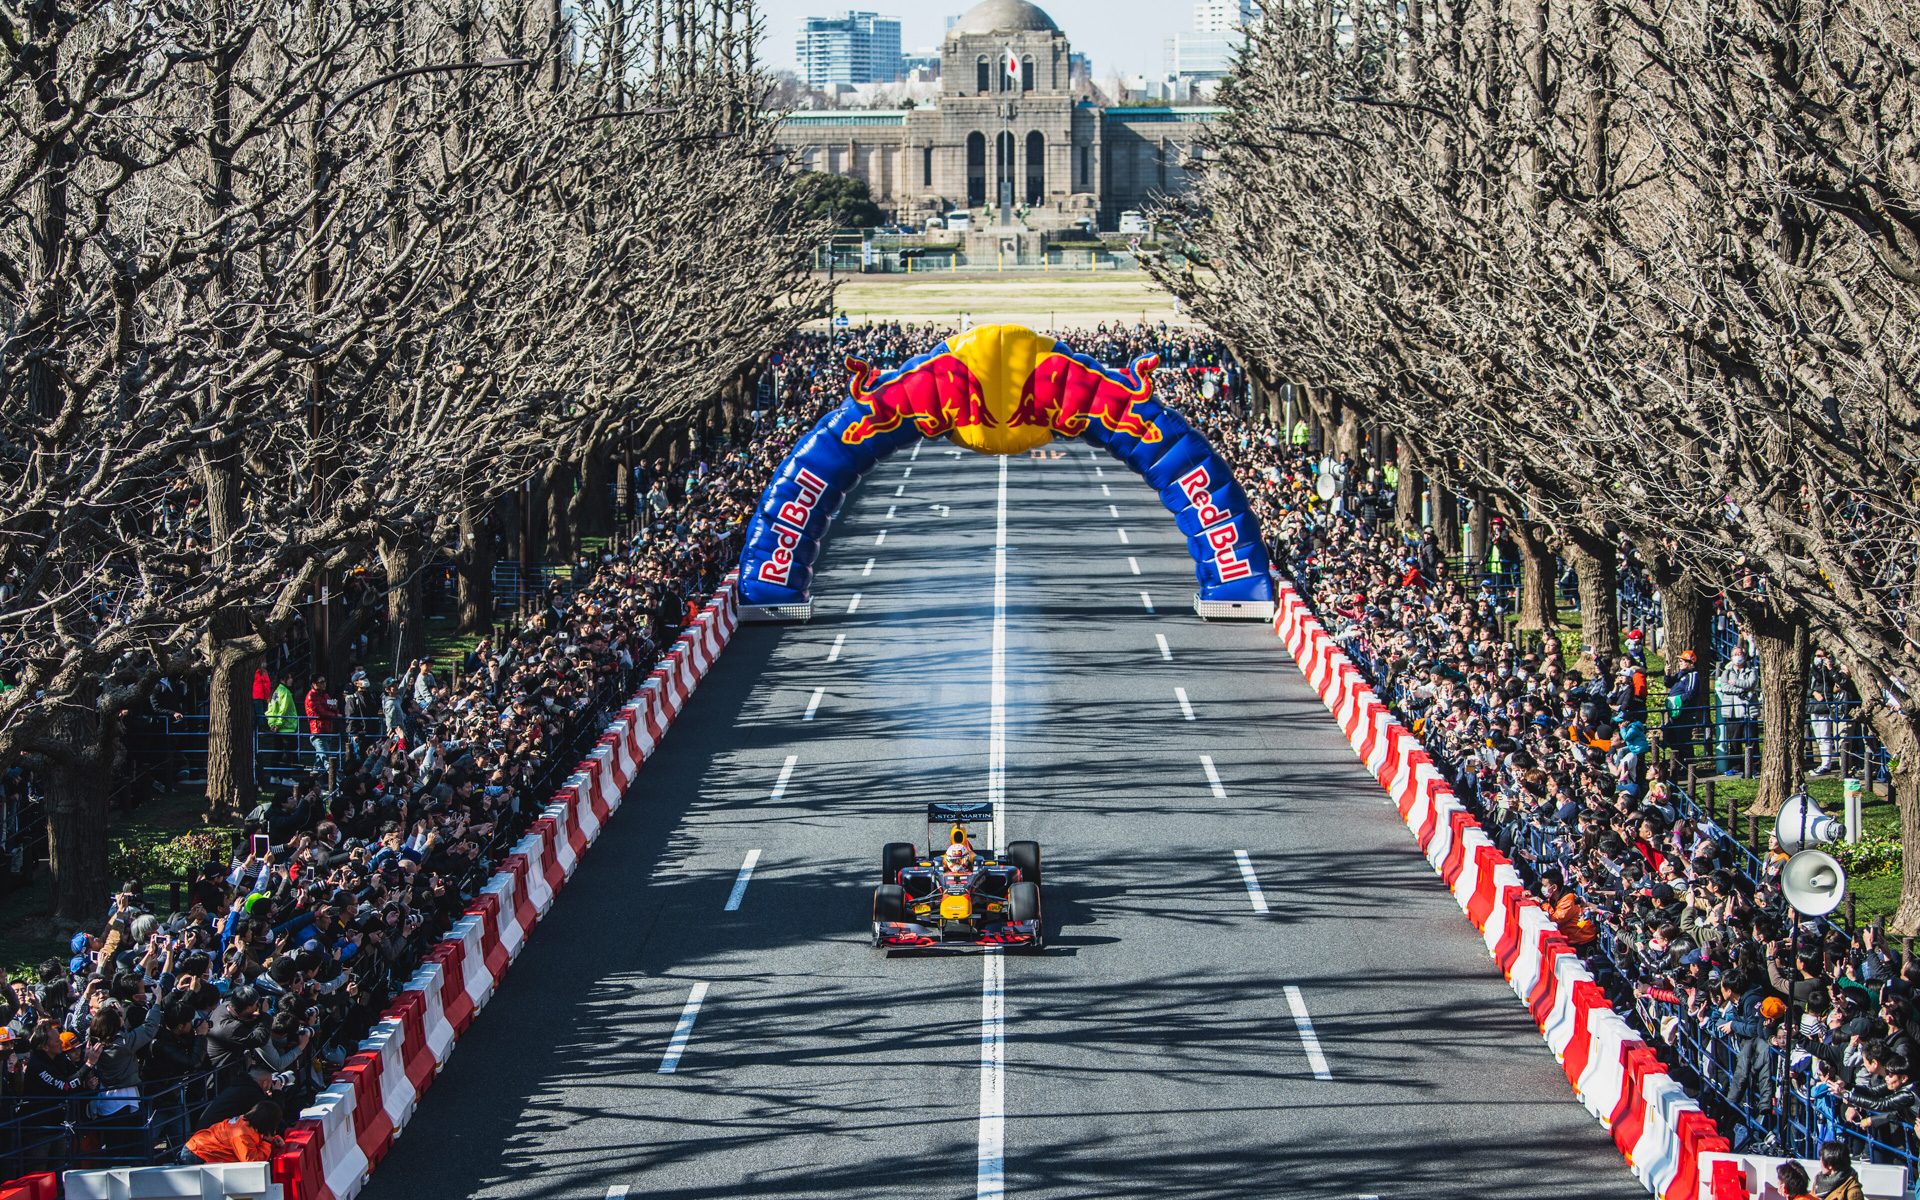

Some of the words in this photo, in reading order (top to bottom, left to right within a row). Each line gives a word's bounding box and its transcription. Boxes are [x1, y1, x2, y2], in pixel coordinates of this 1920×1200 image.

[779, 469, 827, 529] Bull
[1180, 467, 1231, 528] Red
[1208, 524, 1251, 581] Bull
[760, 524, 801, 584] Red
